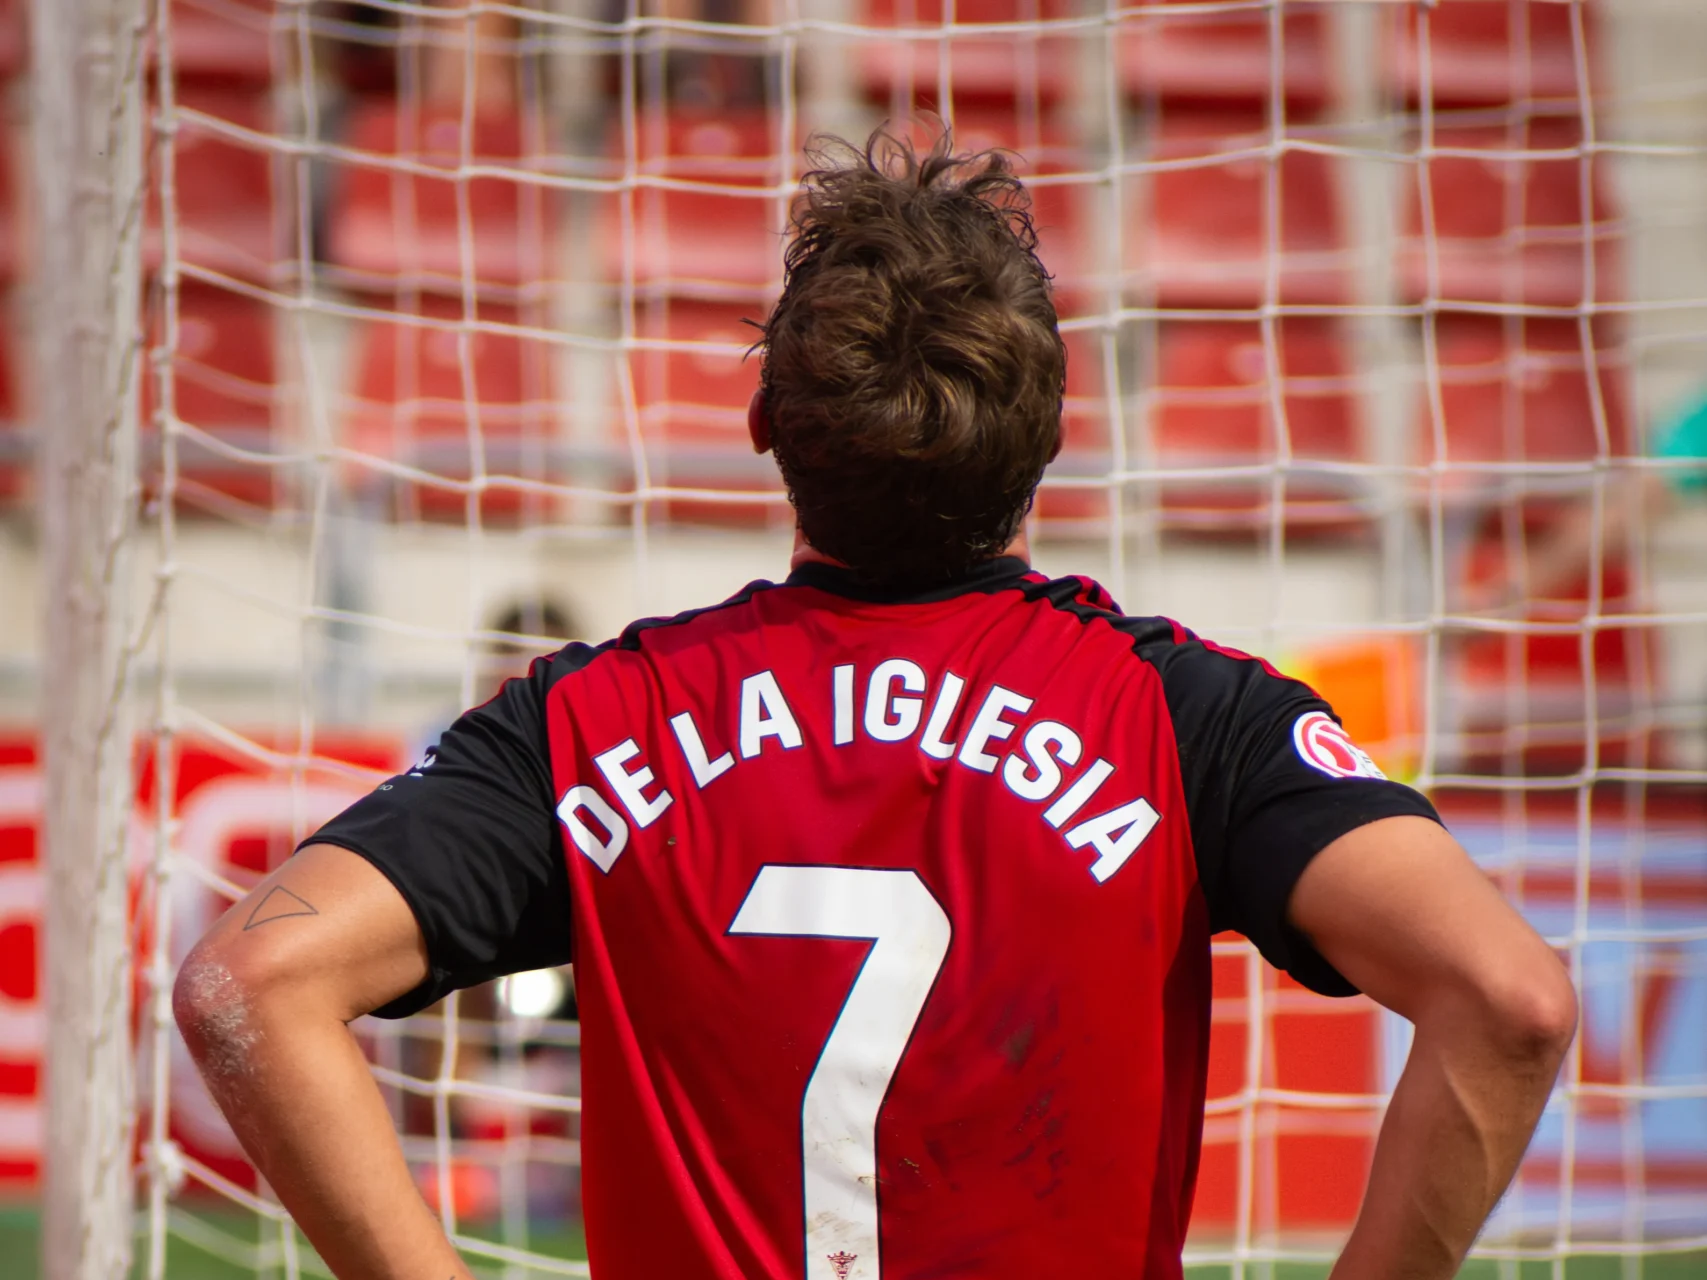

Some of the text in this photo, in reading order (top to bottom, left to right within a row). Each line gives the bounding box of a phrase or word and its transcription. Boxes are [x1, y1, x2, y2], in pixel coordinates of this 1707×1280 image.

[556, 657, 1162, 885] DE LA IGLESIA
